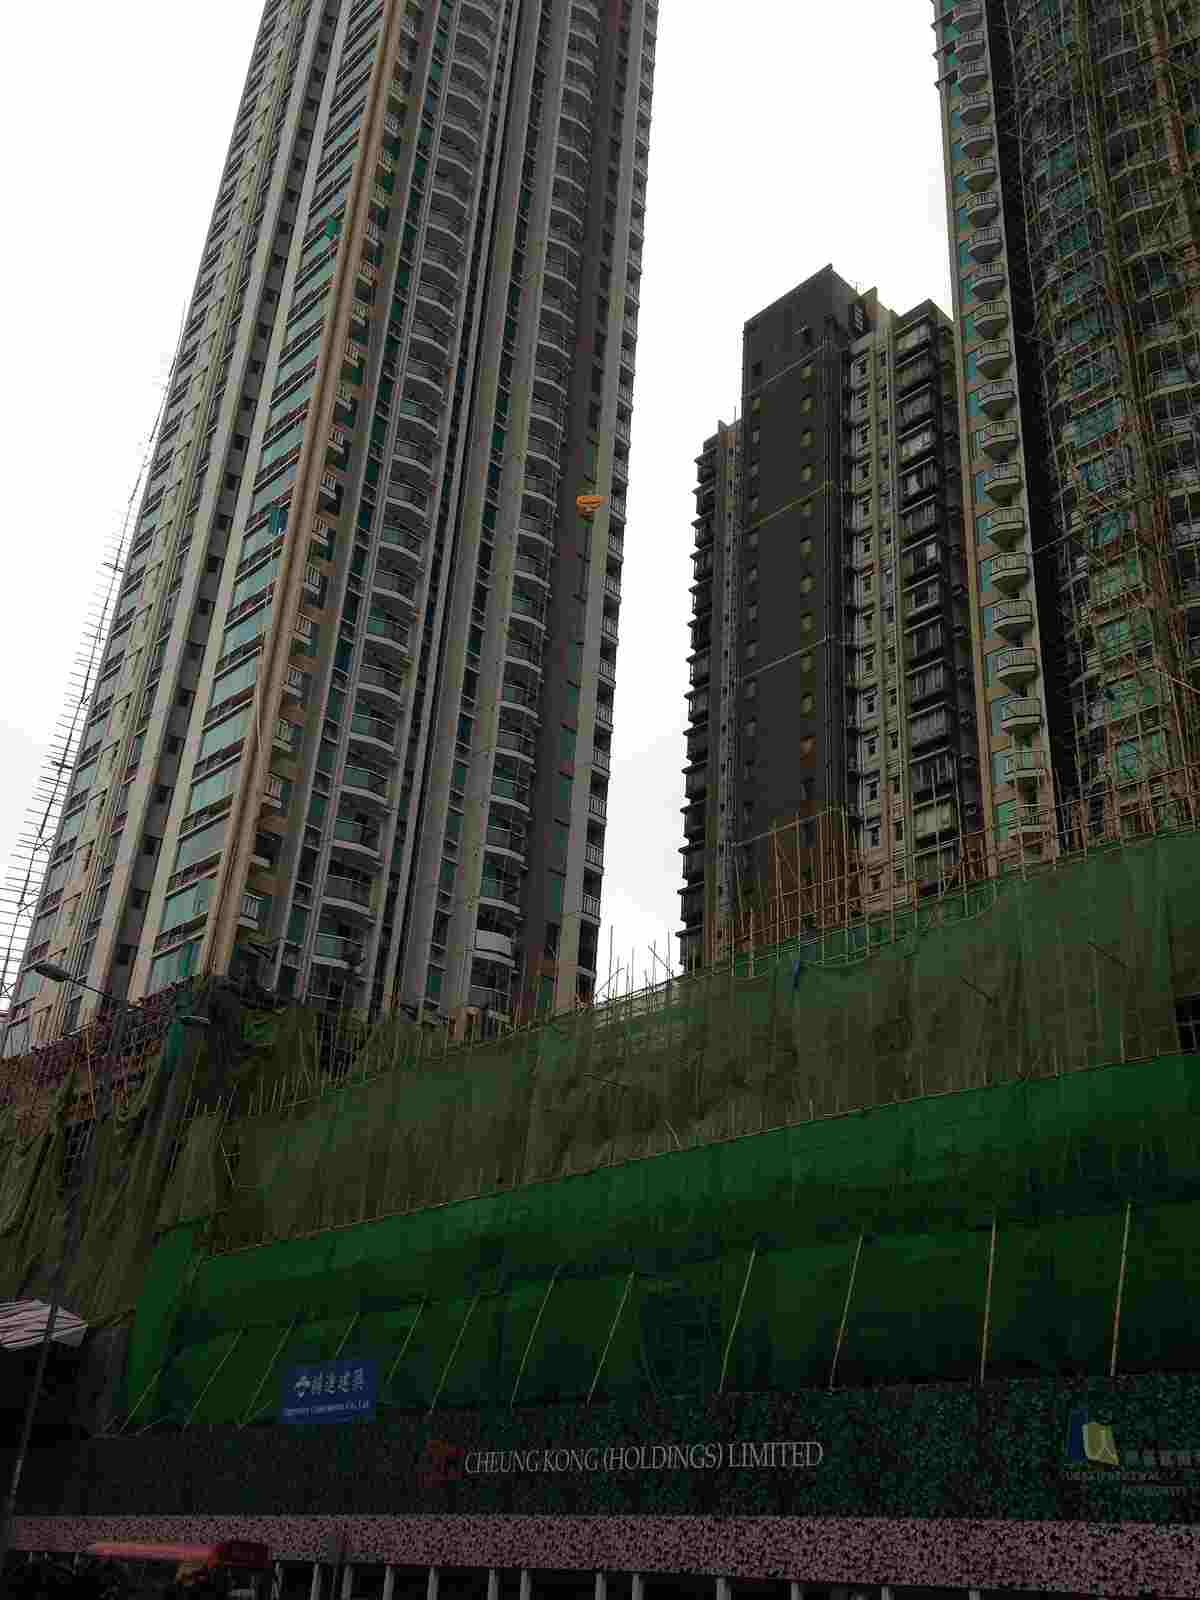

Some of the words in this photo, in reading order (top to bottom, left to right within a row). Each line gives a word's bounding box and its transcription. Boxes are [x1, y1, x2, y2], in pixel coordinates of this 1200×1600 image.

[464, 1447, 538, 1473] CHEUNG
[541, 1445, 599, 1472] KONG
[602, 1442, 723, 1471] (HOLDINGS)
[728, 1440, 824, 1468] LIMITED
